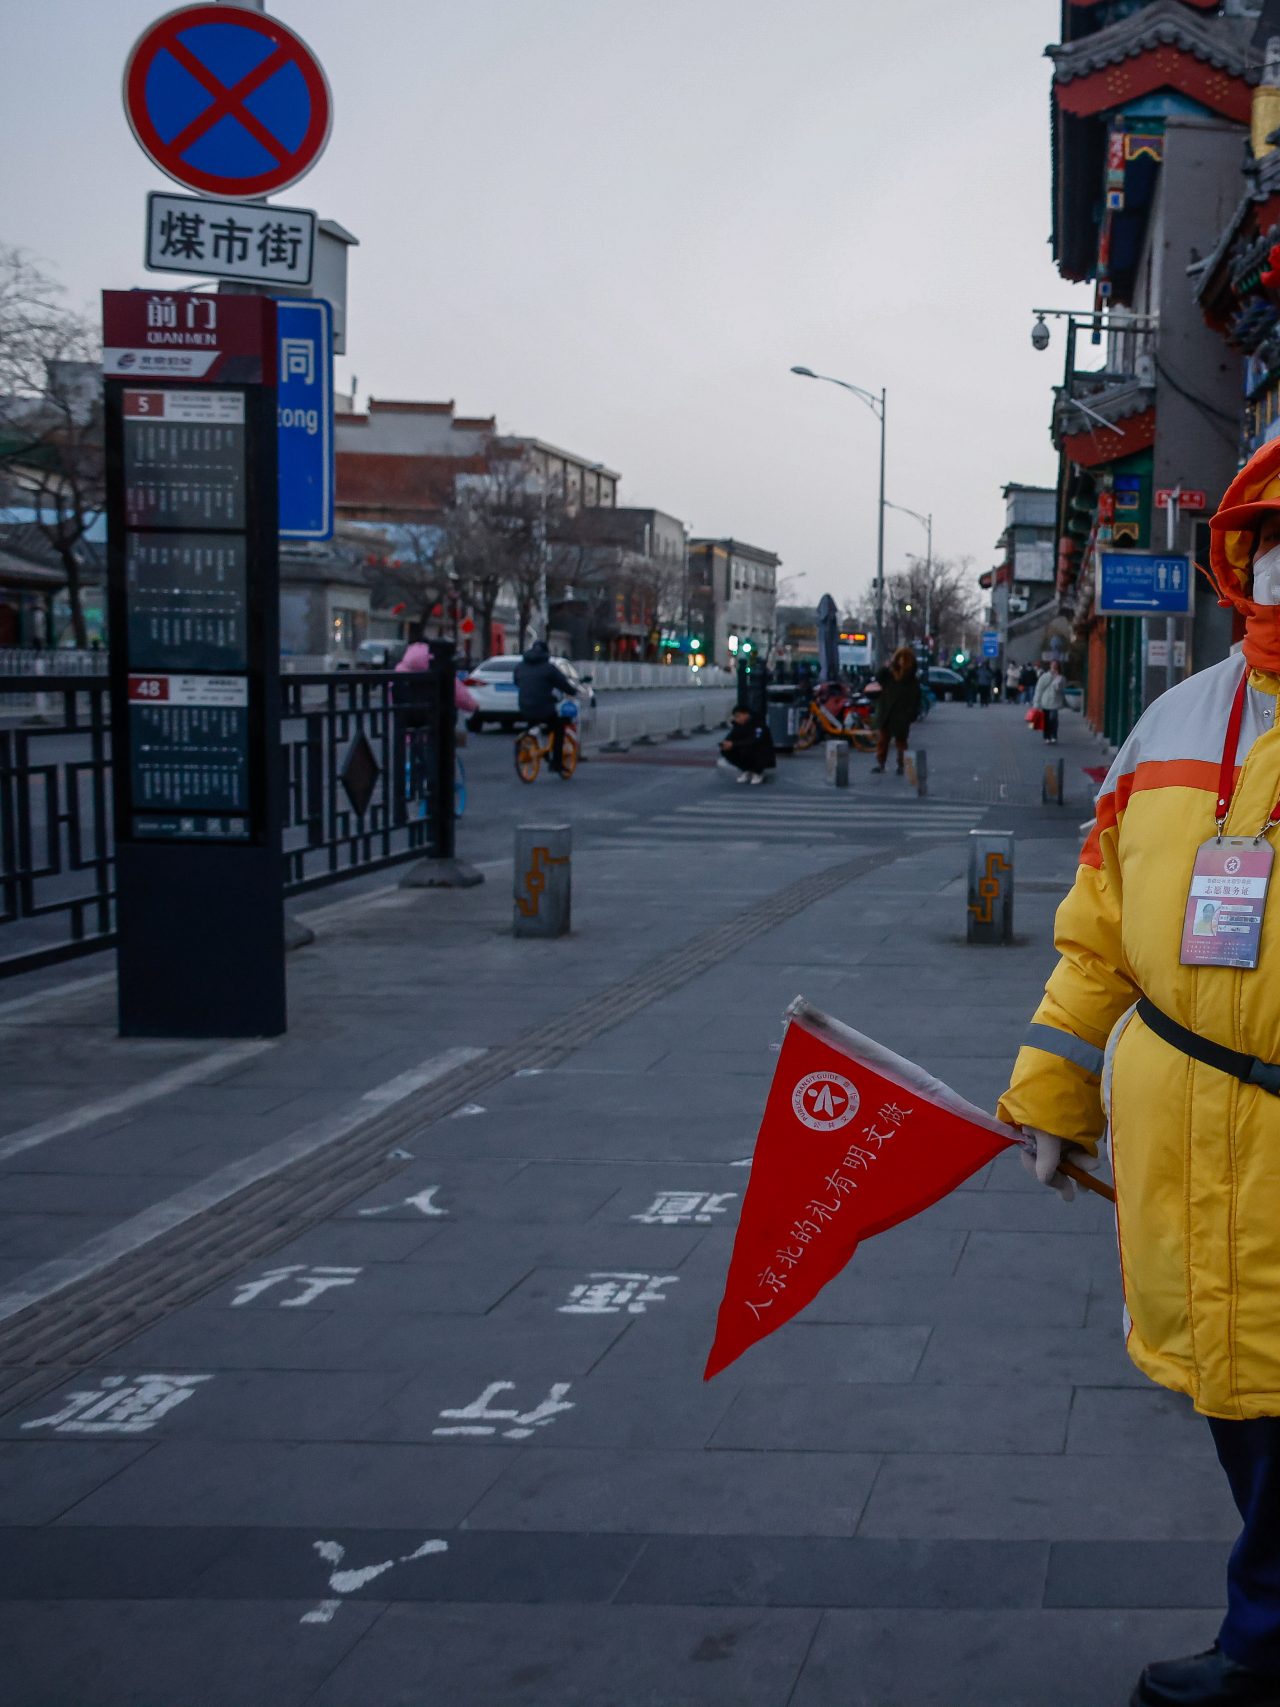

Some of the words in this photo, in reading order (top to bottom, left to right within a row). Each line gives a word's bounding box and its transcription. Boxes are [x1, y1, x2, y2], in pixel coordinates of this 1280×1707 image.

[159, 210, 303, 270] 煤市街
[146, 296, 217, 330] 前门
[281, 338, 315, 385] 同
[138, 396, 150, 413] 5
[136, 680, 161, 697] 48
[795, 1075, 816, 1097] TRANSIT
[816, 1073, 839, 1081] GUIDE
[744, 1101, 914, 1321] 做文明有礼的北京人
